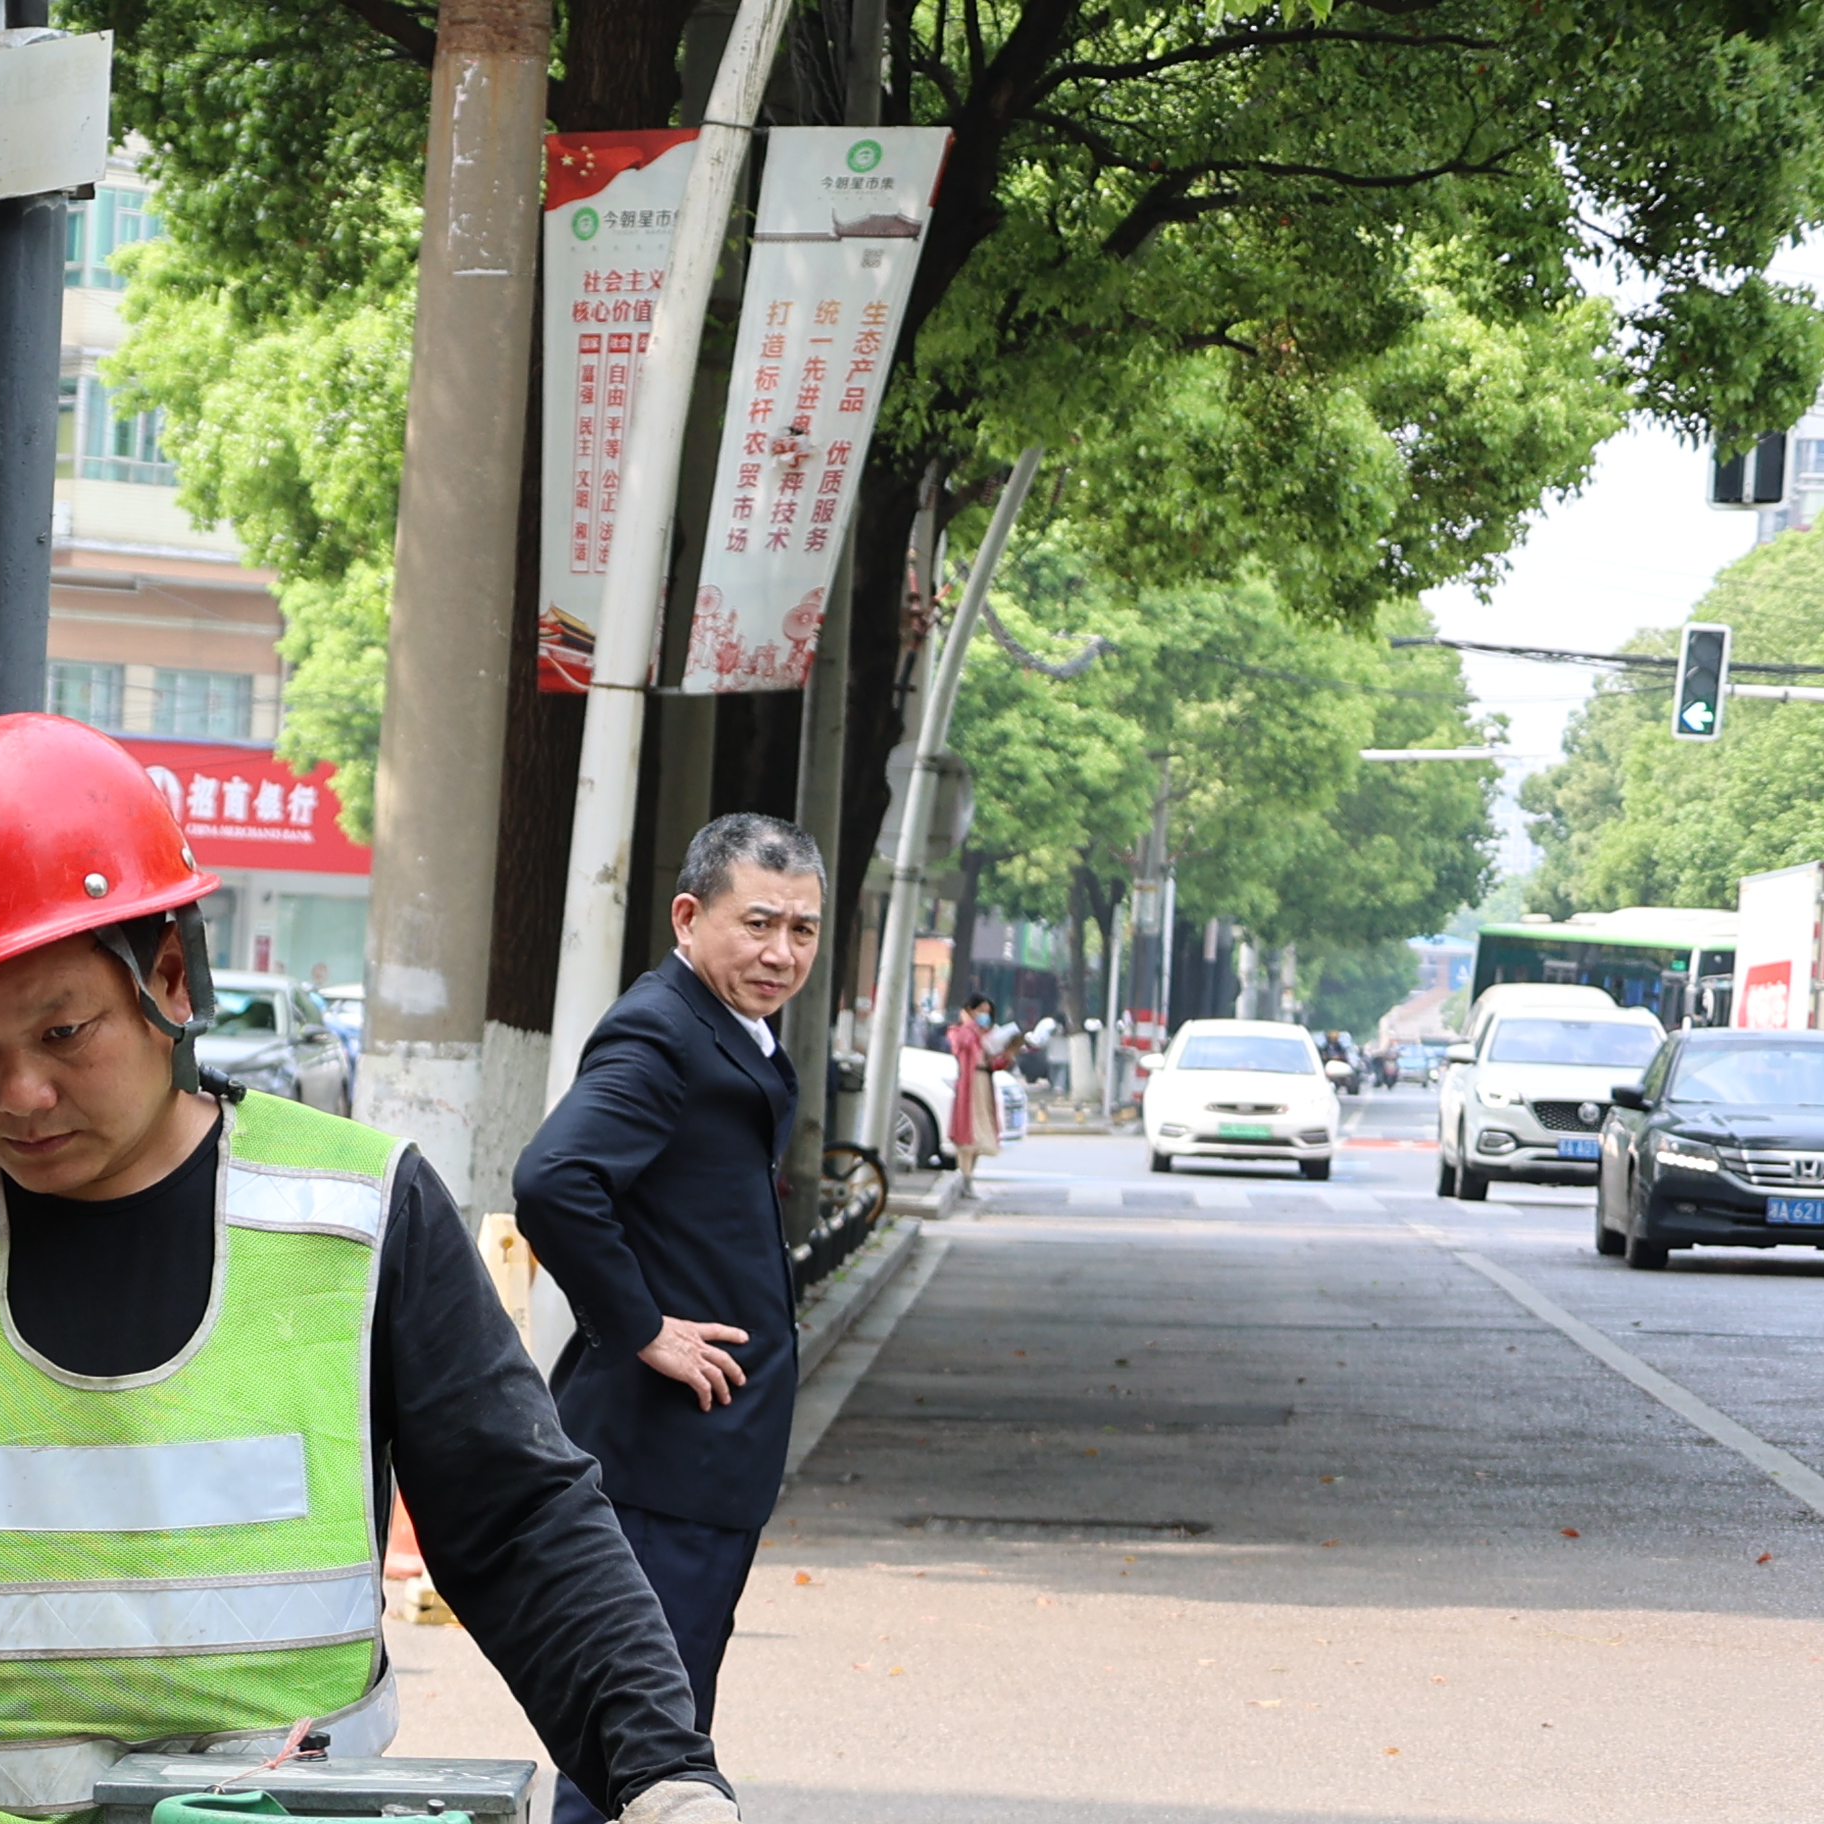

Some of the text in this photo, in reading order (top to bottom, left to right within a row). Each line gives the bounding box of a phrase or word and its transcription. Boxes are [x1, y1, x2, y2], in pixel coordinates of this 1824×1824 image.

[603, 210, 679, 229] 今朝星市
[583, 268, 665, 294] 社会主义
[572, 299, 654, 325] 核心价值
[580, 364, 595, 404] 富强
[607, 364, 626, 407] 自由
[578, 416, 593, 456] 民主
[605, 416, 622, 459] 平等
[725, 299, 795, 553] 打造标杆农贸市场
[803, 299, 891, 552] 生态产品 优质服务
[576, 469, 590, 508] 文明
[601, 468, 620, 512] 公正
[187, 772, 319, 827] 招商银行
